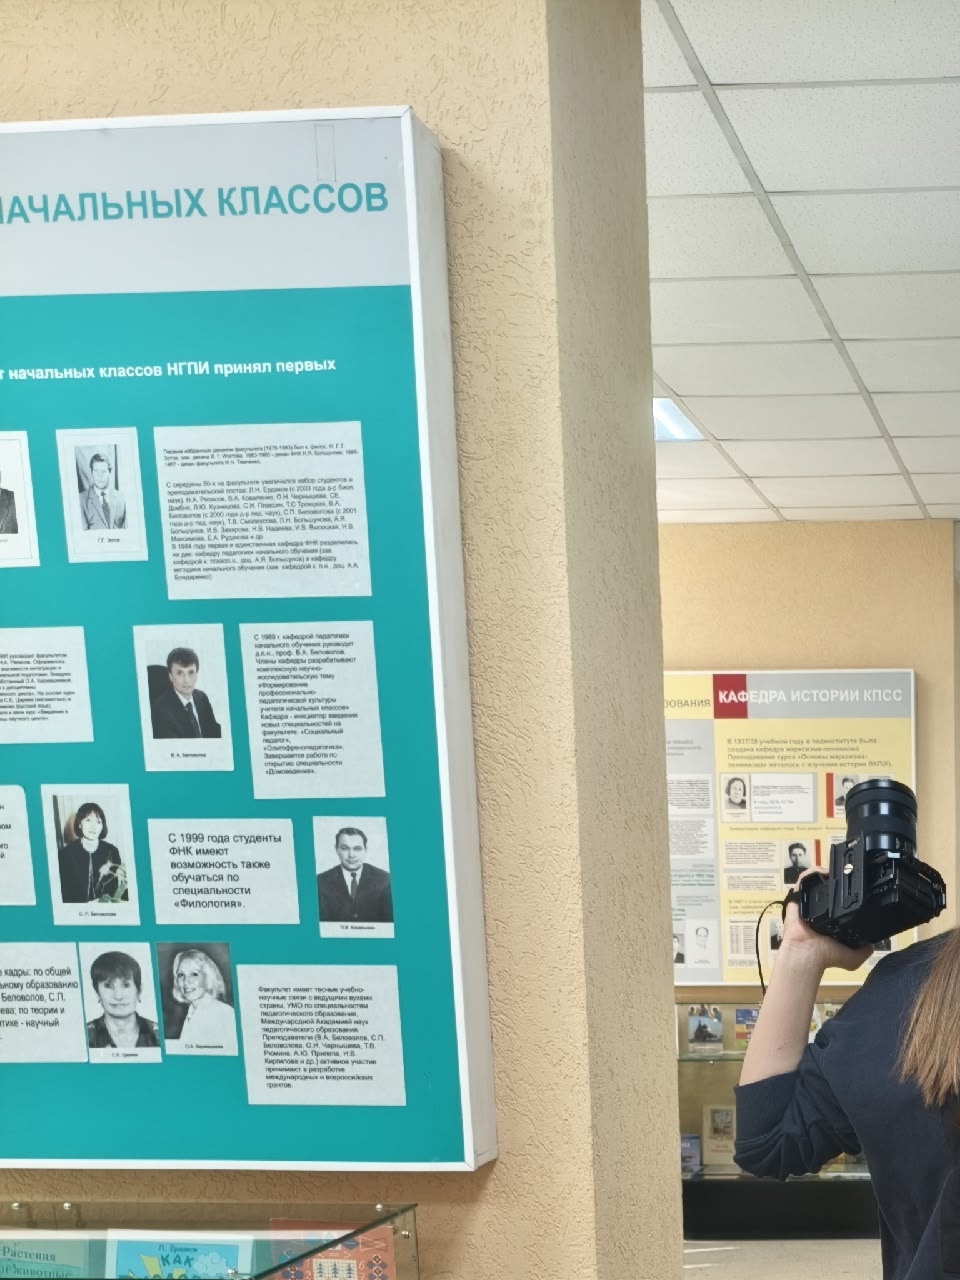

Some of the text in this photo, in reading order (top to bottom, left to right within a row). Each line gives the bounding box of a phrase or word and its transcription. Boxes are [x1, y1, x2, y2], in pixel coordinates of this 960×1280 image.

[218, 182, 390, 216] КЛАССОВ
[8, 365, 95, 380] начальных
[98, 365, 162, 378] классов
[166, 361, 210, 375] НГПИ
[213, 362, 271, 377] принял
[275, 359, 336, 373] первых
[718, 690, 787, 704] КАФЕДРА
[790, 689, 860, 702] ИСТОРИИ
[863, 689, 903, 702] КПСС
[168, 833, 282, 845] С 1999 года студенты
[169, 846, 229, 856] ФНК имеют
[170, 861, 271, 869] возможность также
[171, 873, 240, 884] обучаться по
[172, 887, 251, 896] специальности
[174, 899, 249, 909] «Филология».
[33, 968, 44, 976] по
[44, 966, 72, 977] общей
[25, 979, 79, 991] образованию
[18, 1007, 29, 1015] по
[30, 1007, 59, 1016] теории
[25, 1018, 60, 1030] научный
[160, 1254, 195, 1268] КАК
